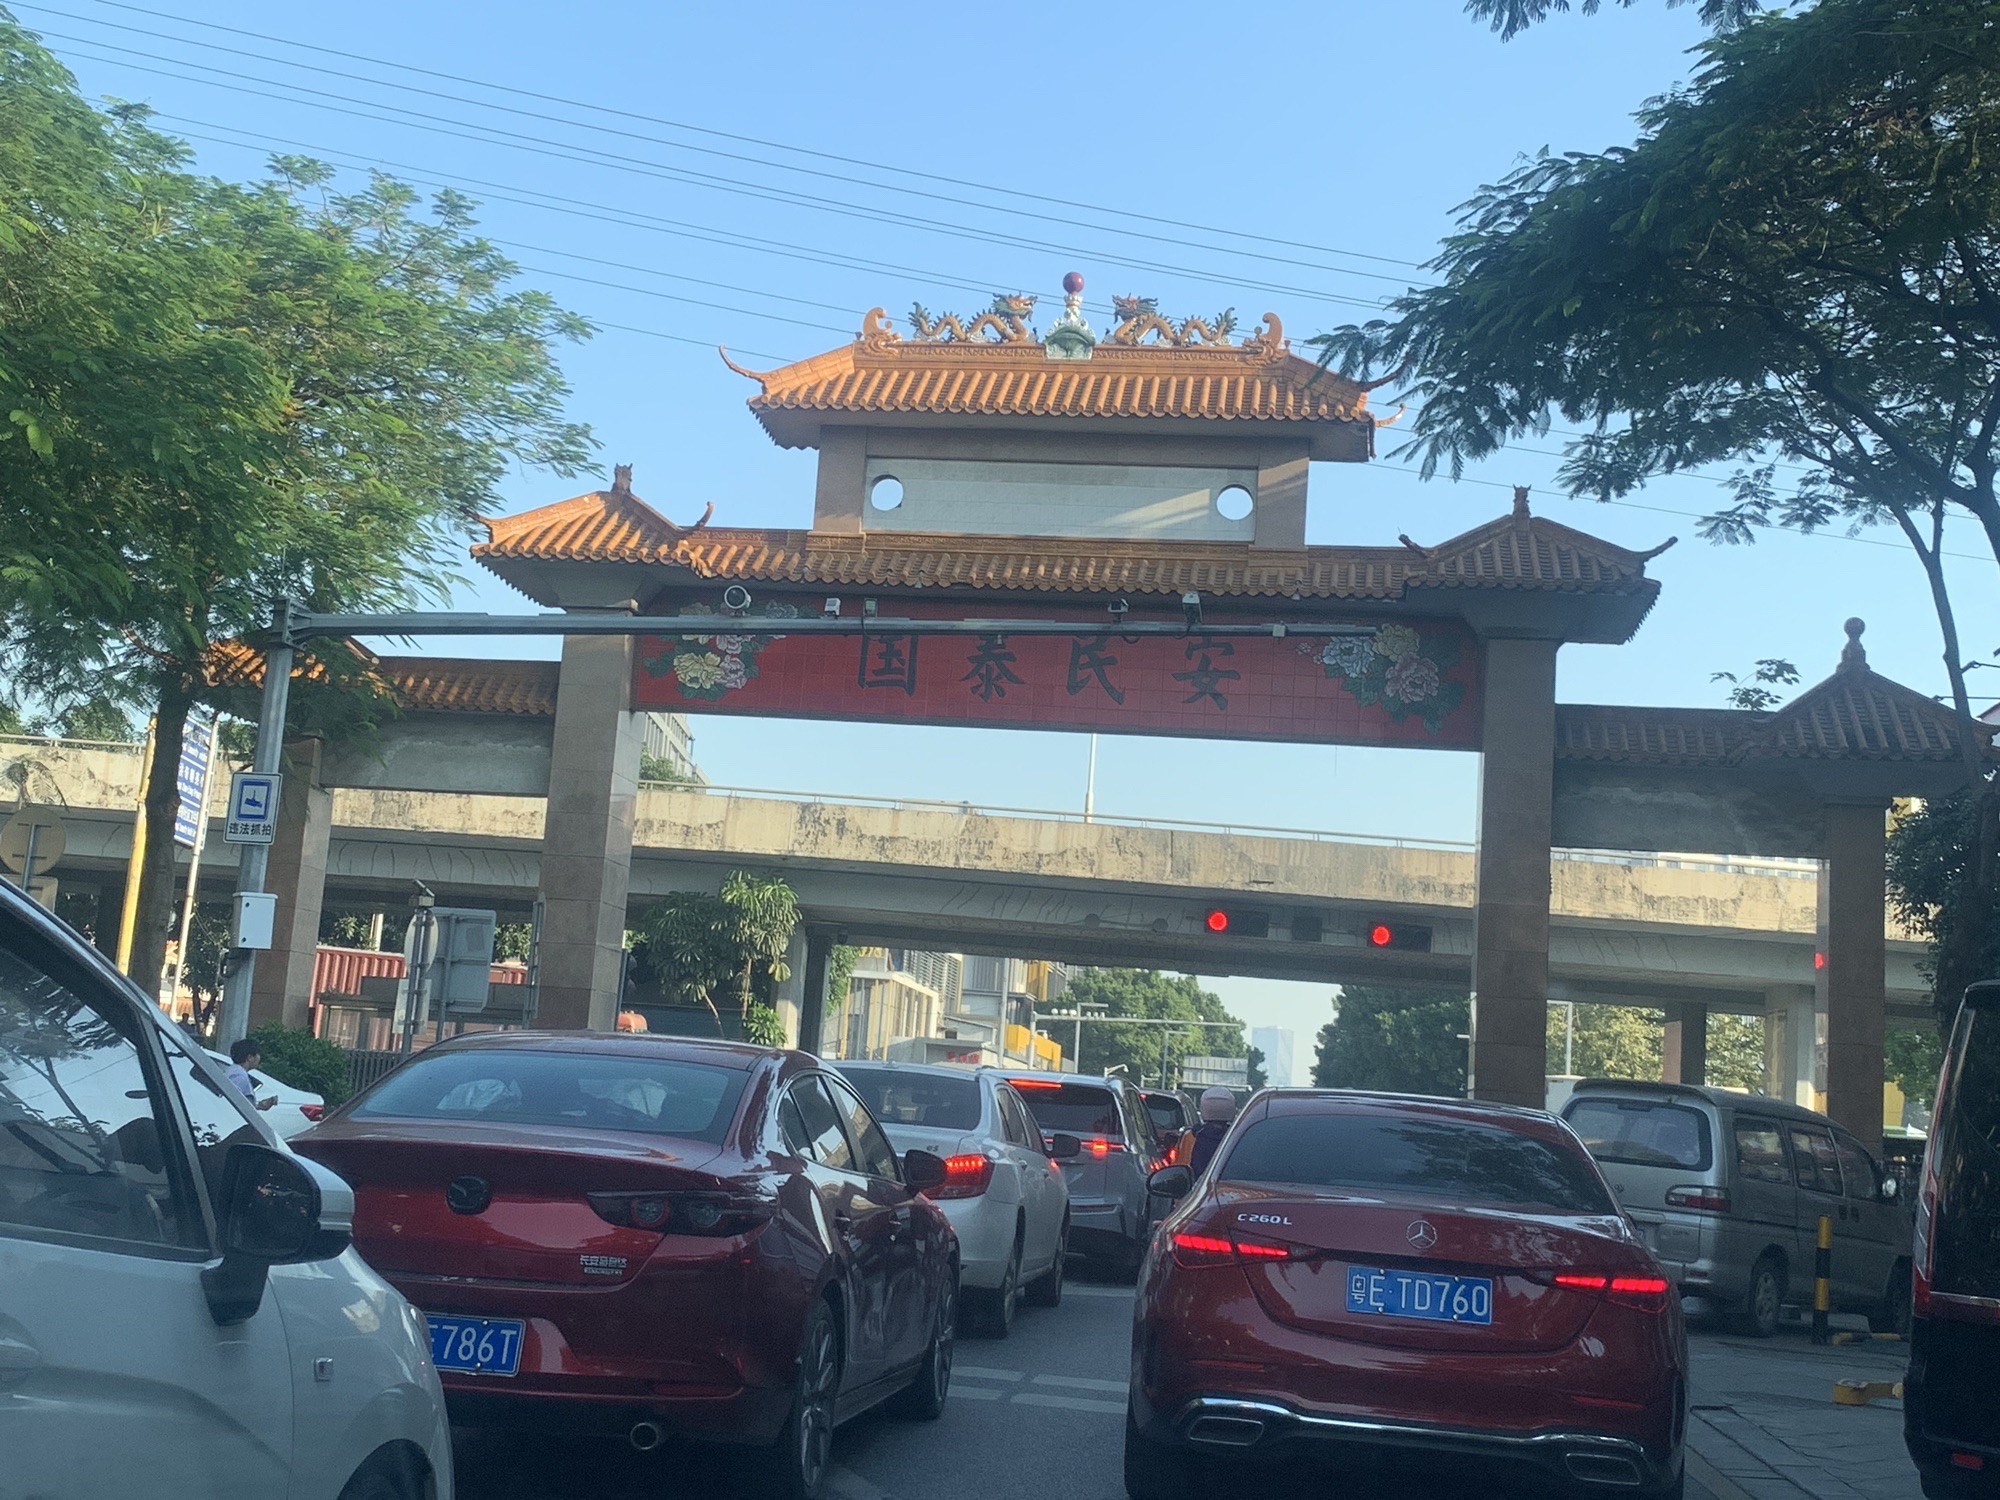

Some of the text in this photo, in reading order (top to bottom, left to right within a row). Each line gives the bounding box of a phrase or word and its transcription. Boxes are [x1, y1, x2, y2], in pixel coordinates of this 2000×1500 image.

[856, 633, 1241, 711] 国泰民安
[228, 822, 272, 836] 违法抓拍
